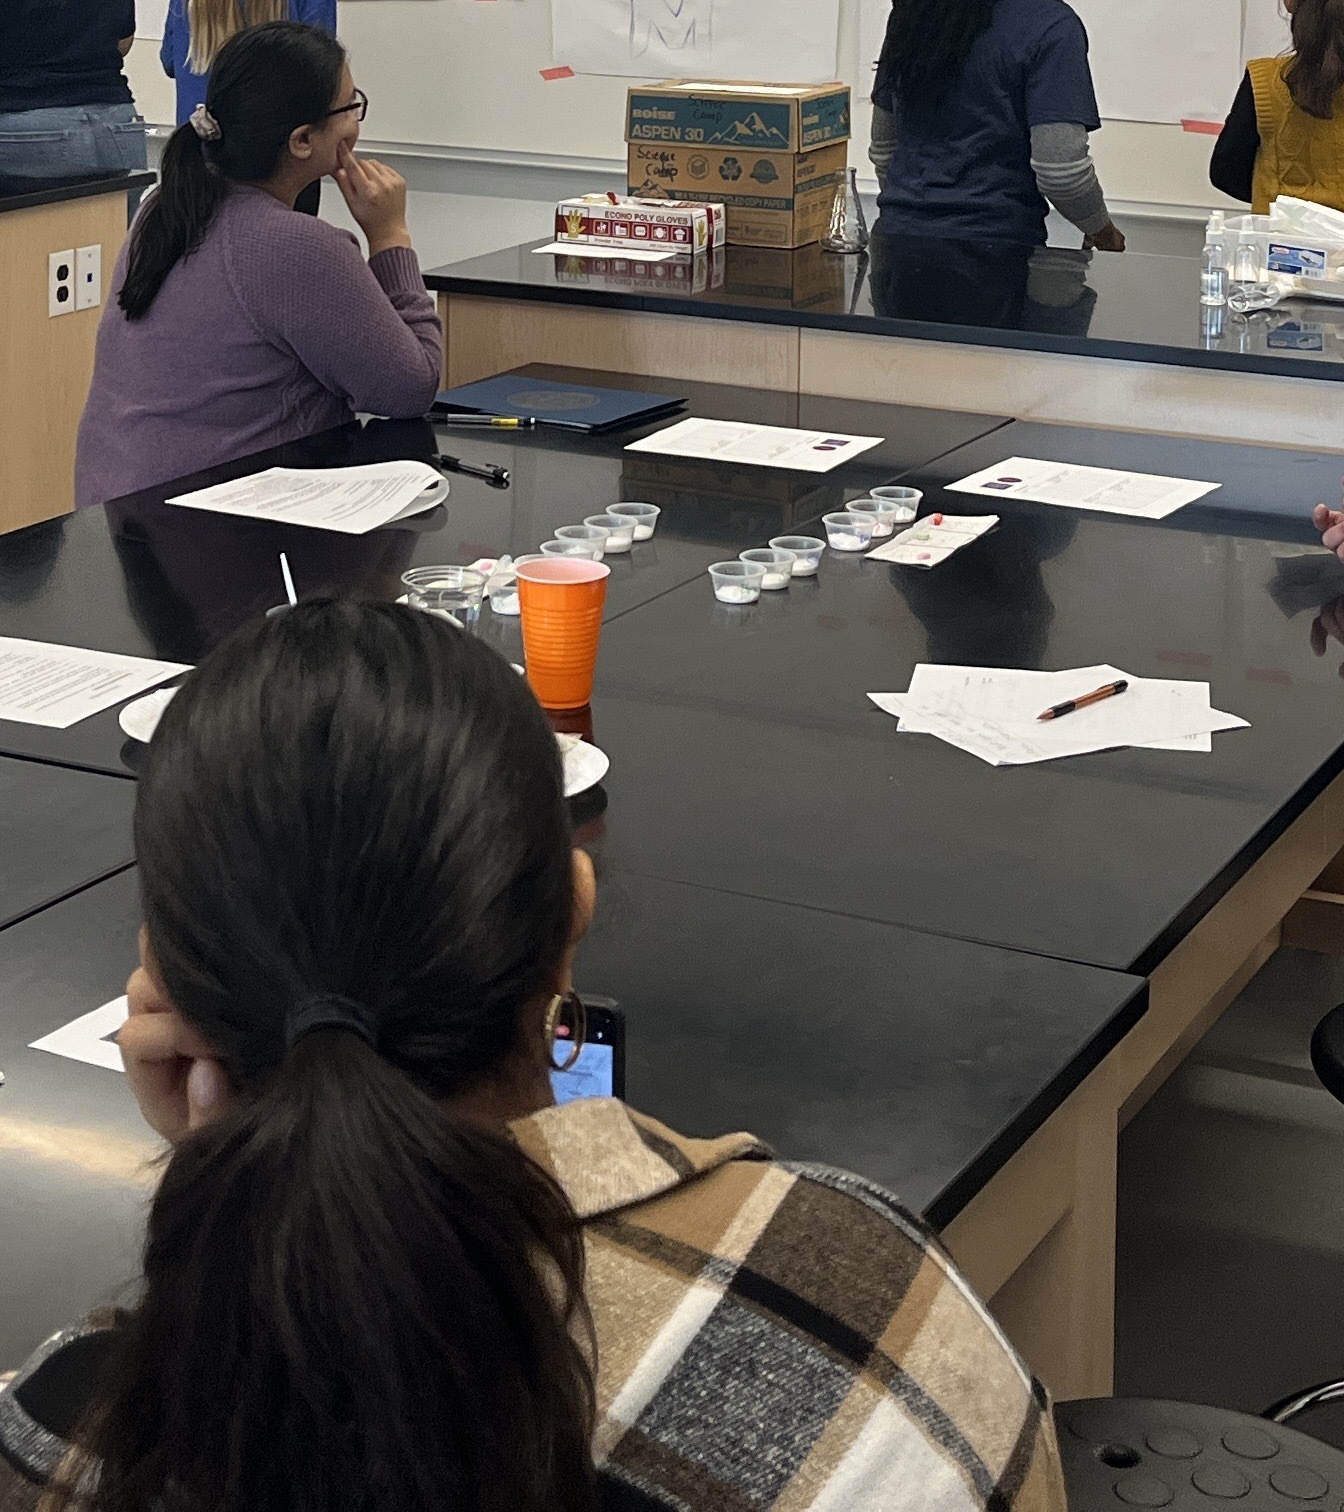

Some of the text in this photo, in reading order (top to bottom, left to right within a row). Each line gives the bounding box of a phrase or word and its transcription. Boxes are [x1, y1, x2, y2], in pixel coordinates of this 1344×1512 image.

[631, 124, 705, 141] ASPEN 30
[605, 210, 688, 225] ECONO POLY GLOVES
